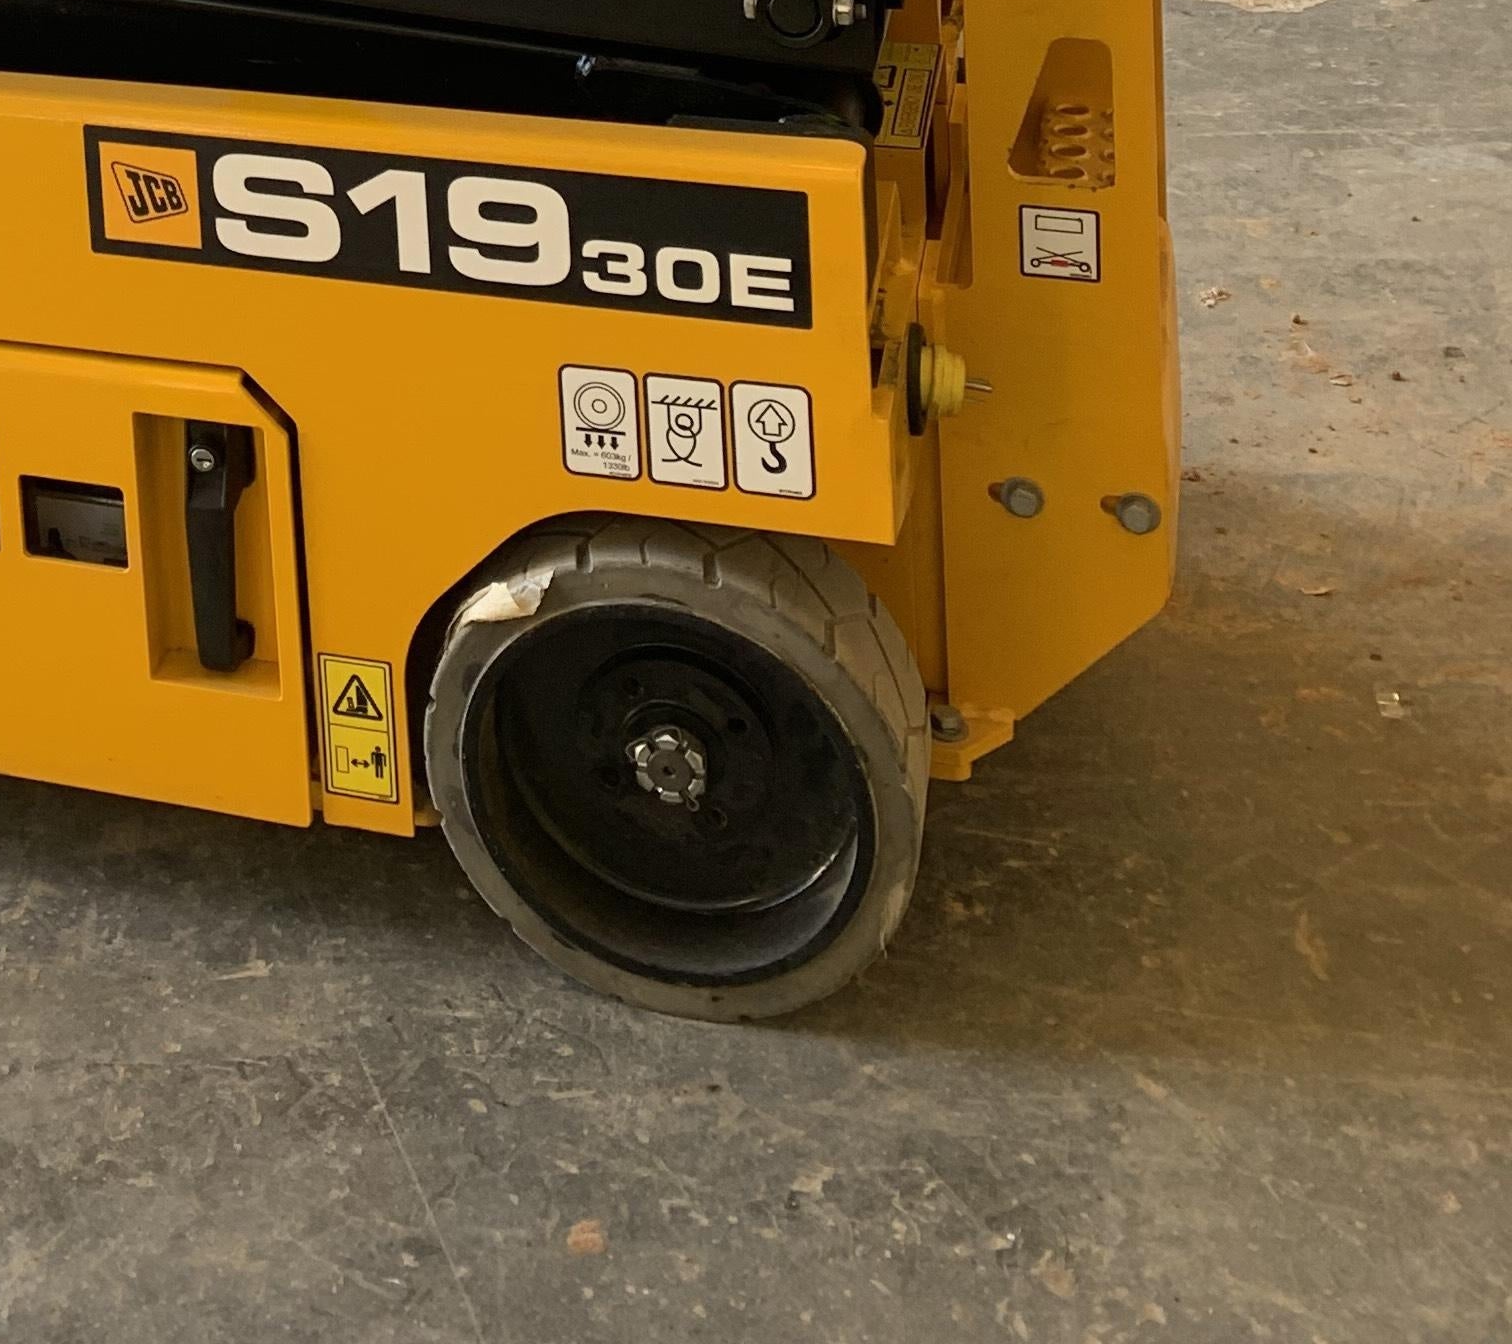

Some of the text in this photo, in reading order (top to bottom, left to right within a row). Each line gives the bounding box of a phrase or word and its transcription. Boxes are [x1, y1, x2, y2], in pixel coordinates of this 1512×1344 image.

[125, 168, 183, 216] JCB
[212, 153, 795, 312] S19 30E
